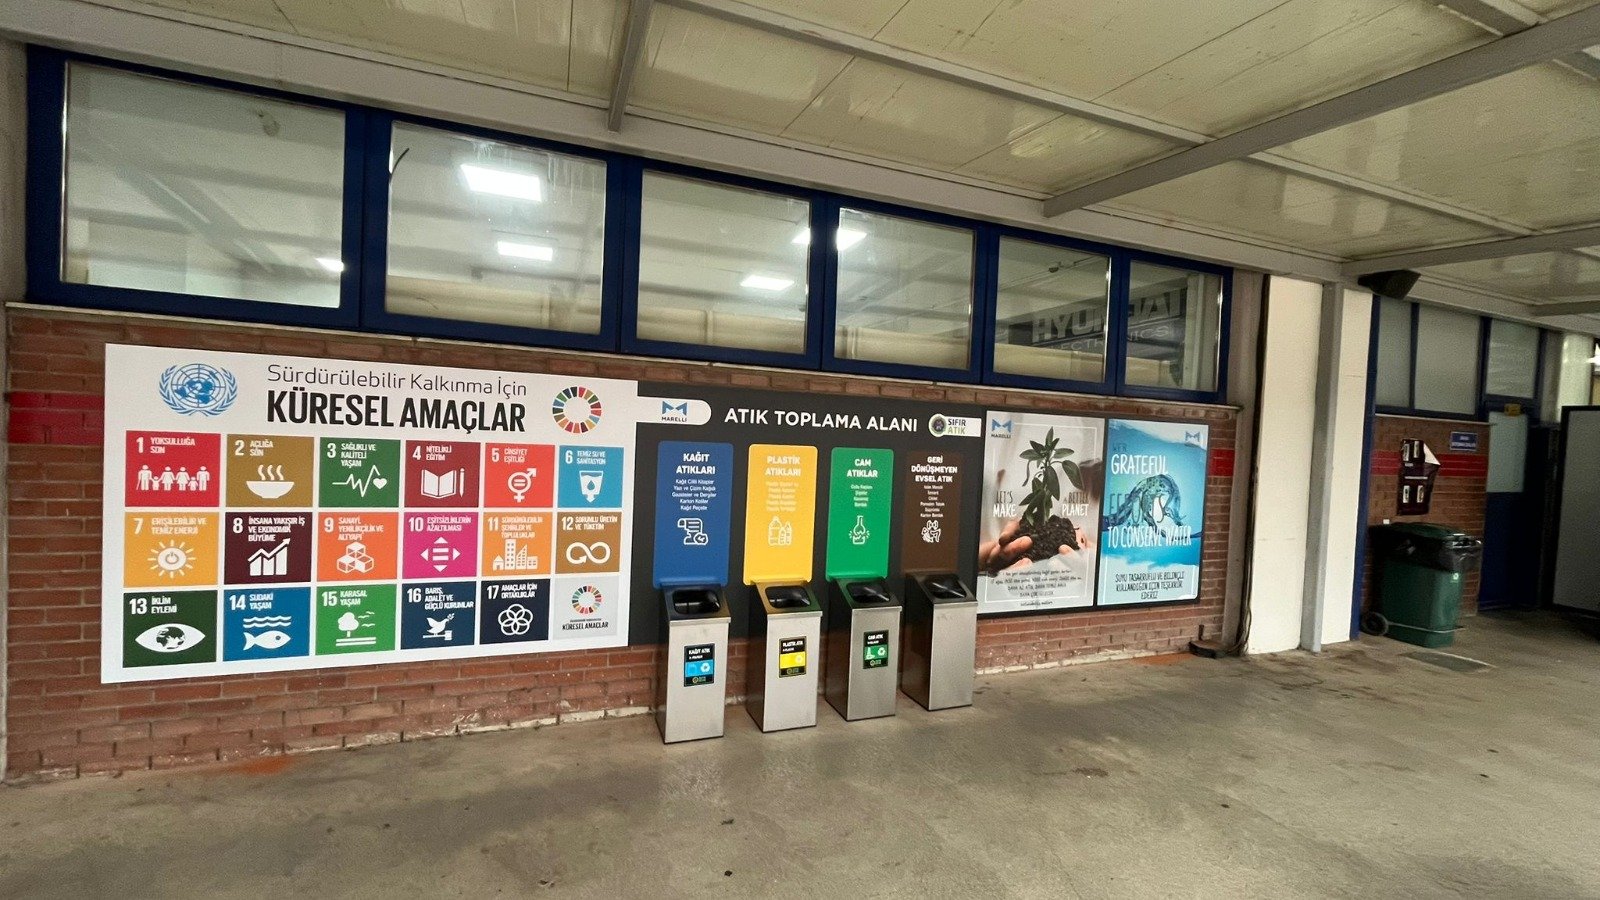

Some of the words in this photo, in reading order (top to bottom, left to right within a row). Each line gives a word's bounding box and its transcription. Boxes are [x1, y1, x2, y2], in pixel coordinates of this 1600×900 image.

[268, 364, 405, 388] Sürdürülebilir
[411, 373, 492, 394] Kalkınma
[498, 377, 527, 399] İçin
[267, 386, 394, 427] KÜRESEL
[400, 398, 526, 434] AMAÇLAR
[724, 408, 768, 424] ATIK
[774, 411, 862, 429] TOPLAMA
[866, 416, 917, 432] ALANI
[136, 437, 144, 454] 1
[150, 436, 195, 446] YOKSULLUĞA
[150, 446, 165, 454] SON
[235, 440, 245, 456] 2
[250, 439, 274, 449] AÇLIĞA
[327, 443, 336, 458] 3
[341, 442, 367, 450] SAĞLIKLI
[341, 451, 367, 459] KALİTELİ
[412, 446, 421, 460] 4
[426, 445, 452, 453] NİTELİKLİ
[426, 453, 445, 461] EĞİTİM
[492, 448, 499, 462] 5
[504, 447, 527, 456] CİNSİYET
[566, 450, 573, 464] 6
[683, 452, 710, 462] KAĞIT
[927, 455, 943, 463] GERİ
[341, 460, 361, 468] YAŞAM
[504, 455, 525, 464] EŞİTLİĞİ
[767, 455, 800, 464] PLASTİK
[855, 459, 871, 467] CAM
[1111, 454, 1168, 475] GRATEFUL
[676, 466, 715, 474] ATIKLARI
[765, 468, 801, 476] ATIKLARI
[846, 470, 878, 478] ATIKLAR
[911, 464, 958, 474] DÖNÜŞMEYEN
[996, 491, 1013, 503] LET'S
[993, 504, 1017, 517] MAKE
[1062, 504, 1089, 517] PLANET
[134, 518, 143, 534] 7
[152, 526, 172, 534] TEMİZ
[233, 517, 243, 533] 8
[248, 516, 272, 524] İNSANA
[273, 517, 297, 526] YAKIŞIR
[298, 516, 305, 526] İŞ
[258, 525, 291, 533] EKONOMİK
[324, 517, 334, 532] 9
[409, 517, 424, 532] 10
[488, 517, 498, 531] 11
[561, 517, 573, 530] 12
[248, 533, 276, 541] BÜYÜME
[1108, 526, 1119, 548] TO
[1121, 526, 1162, 548] CONSERVE
[1165, 526, 1191, 546] WATER
[407, 588, 421, 603] 16
[487, 585, 499, 599] 17
[502, 584, 526, 592] AMAÇLAR
[527, 582, 537, 591] İÇİN
[502, 591, 536, 599] ORTAKLIKLAR
[230, 595, 246, 610] 14
[250, 593, 273, 602] SUDAKİ
[322, 591, 337, 606] 15
[340, 598, 361, 607] YAŞAM
[130, 598, 147, 615] 13
[151, 596, 171, 605] İKLİM
[151, 605, 177, 614] EYLEMİ
[250, 602, 272, 611] YAŞAM
[425, 602, 443, 611] GÜÇLÜ
[562, 622, 583, 630] KÜRESEL
